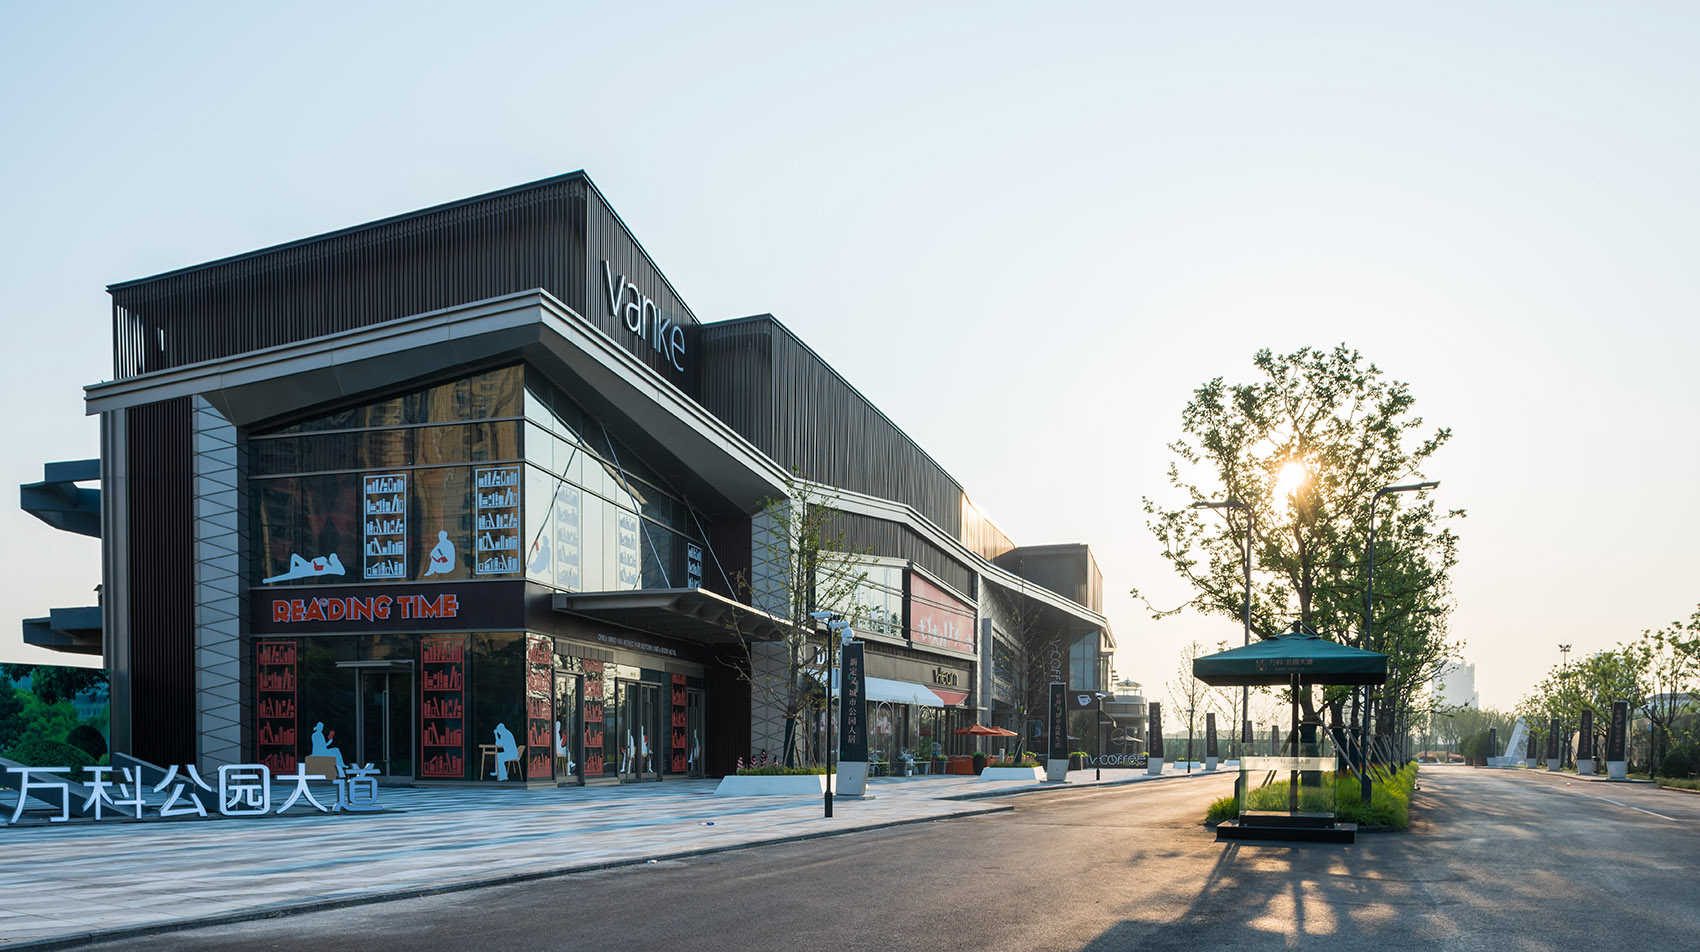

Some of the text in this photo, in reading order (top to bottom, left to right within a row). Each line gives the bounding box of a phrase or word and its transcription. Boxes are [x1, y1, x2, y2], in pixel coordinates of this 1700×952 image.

[273, 593, 459, 623] READING TIME
[6, 763, 384, 824] 万科公园大道
